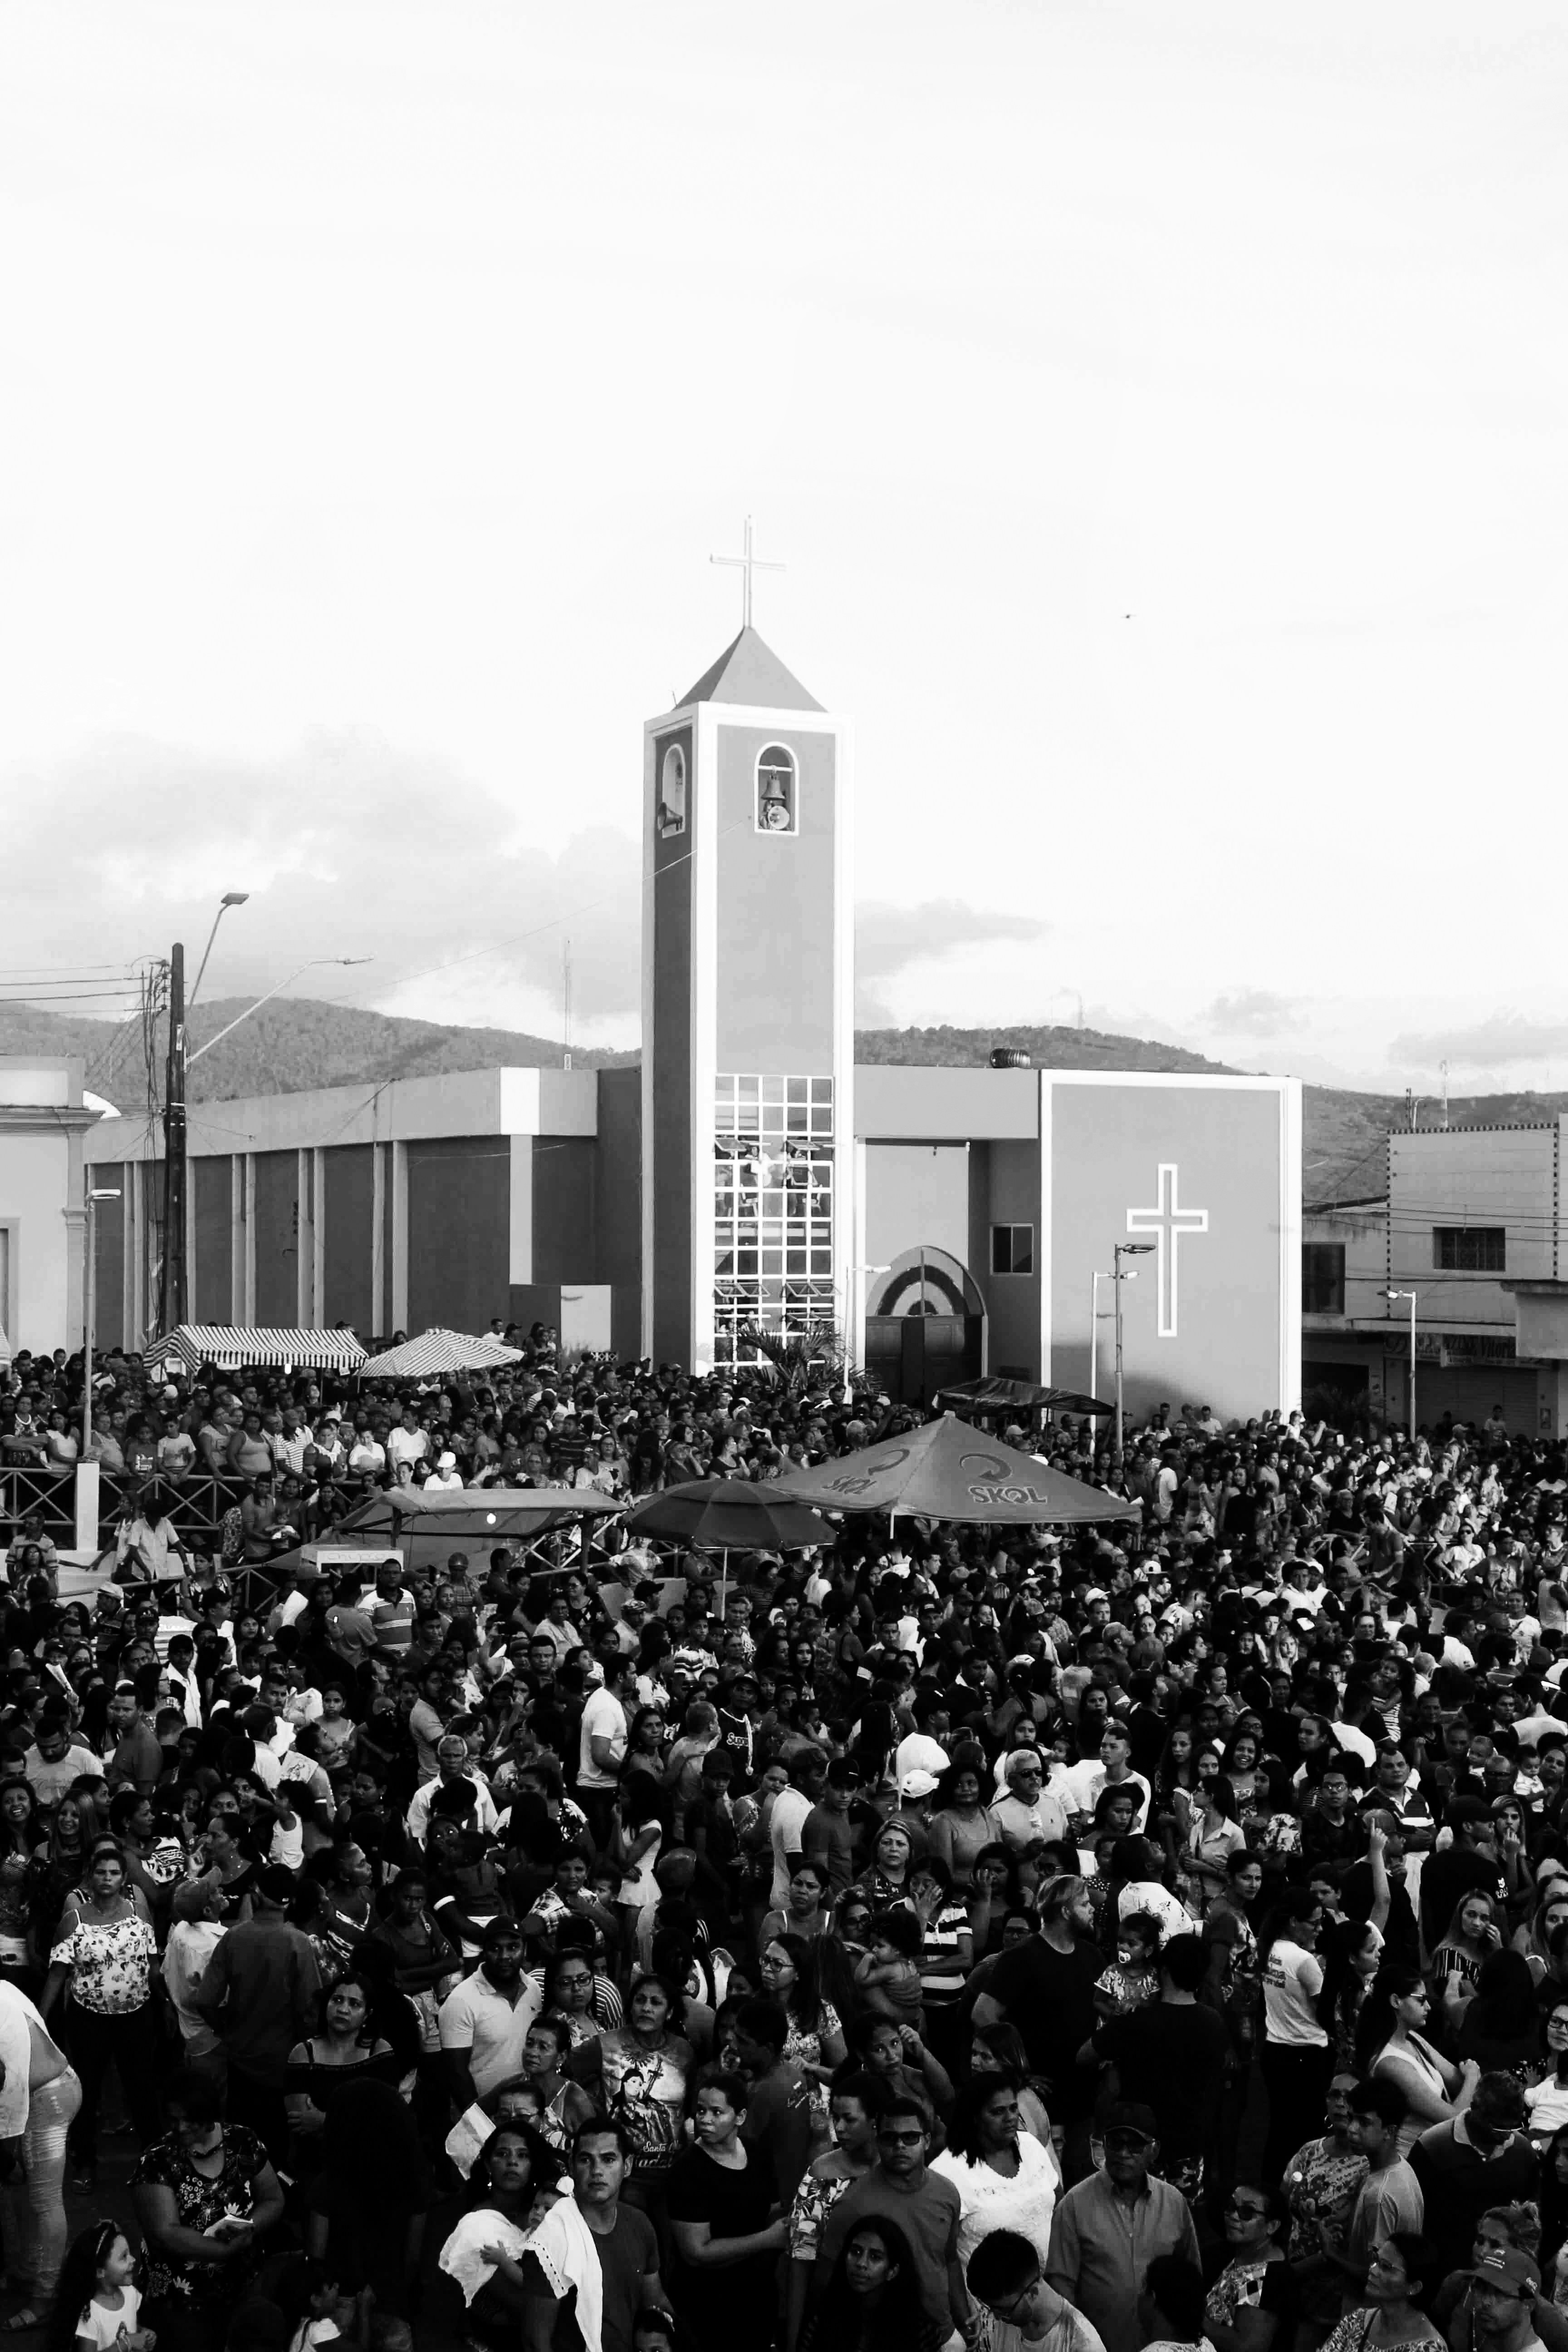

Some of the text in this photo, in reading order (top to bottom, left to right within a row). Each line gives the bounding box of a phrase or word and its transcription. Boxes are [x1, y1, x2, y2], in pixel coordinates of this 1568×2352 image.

[821, 1475, 877, 1495] SKOL
[968, 1486, 1048, 1504] SKOL
[643, 2141, 667, 2152] Santa
